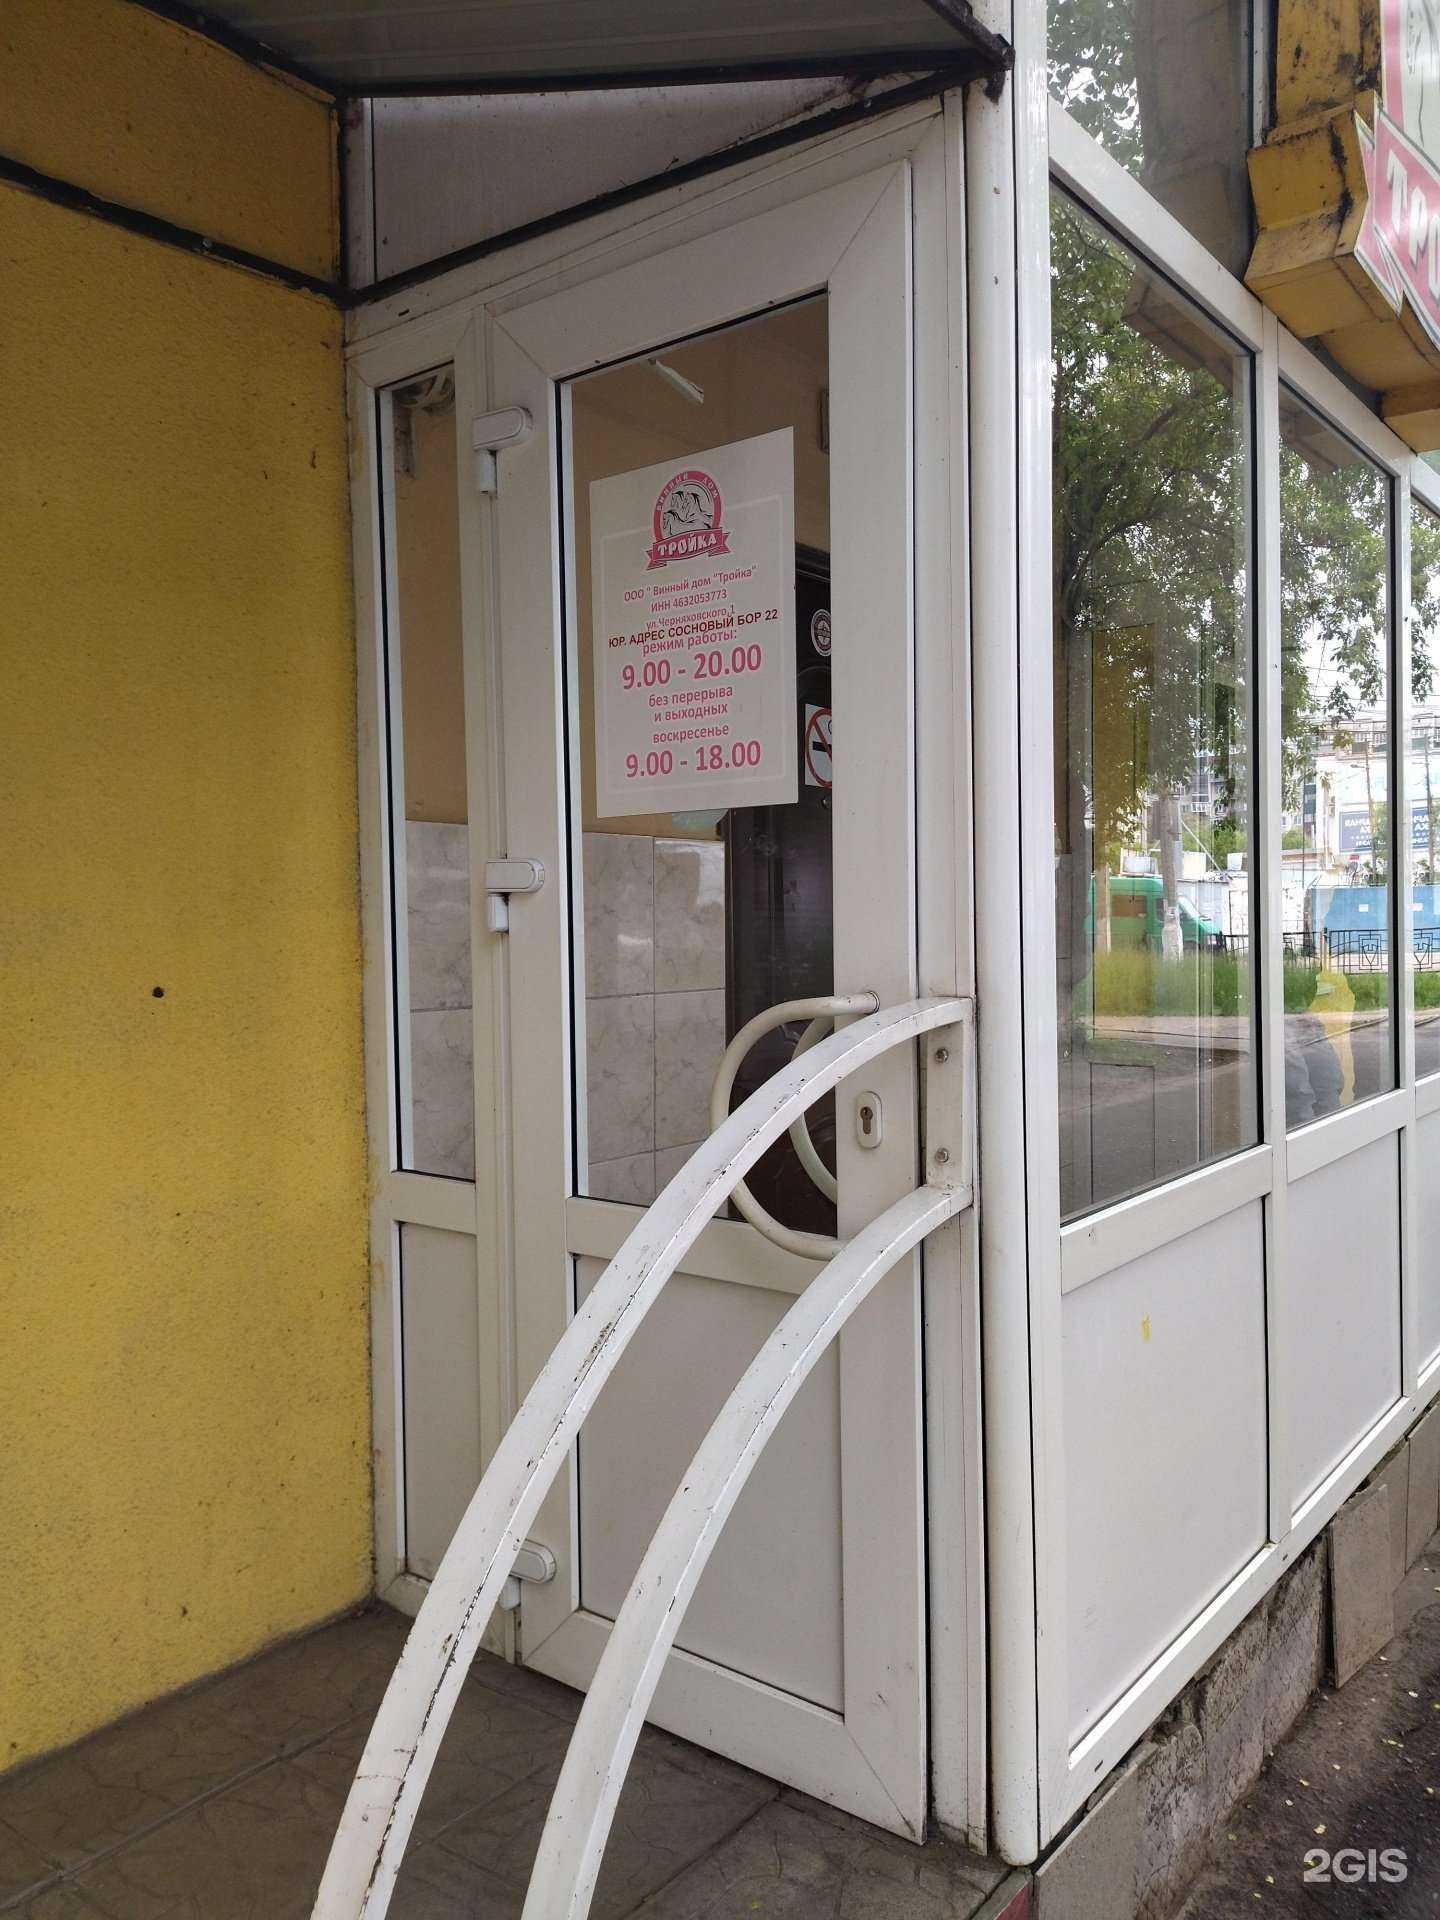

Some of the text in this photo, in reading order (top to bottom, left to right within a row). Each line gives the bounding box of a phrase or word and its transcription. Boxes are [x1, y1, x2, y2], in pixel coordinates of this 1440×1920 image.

[657, 532, 717, 556] ТРОЙКА
[624, 591, 645, 602] ООО
[653, 580, 689, 596] Винный
[691, 577, 711, 589] дом
[651, 589, 727, 613] ИНН 4632053773
[608, 608, 779, 649] ЮР. АДРЕС СОСНОВЫЙ БОР 22
[642, 629, 737, 657] режим работы:
[622, 659, 671, 690] 9.00
[693, 643, 762, 679] 20.00
[648, 685, 733, 707] без перерыва
[654, 703, 728, 722] и выходных
[652, 724, 730, 744] воскресенье
[626, 750, 673, 778] 9.00
[695, 740, 761, 771] 18.00
